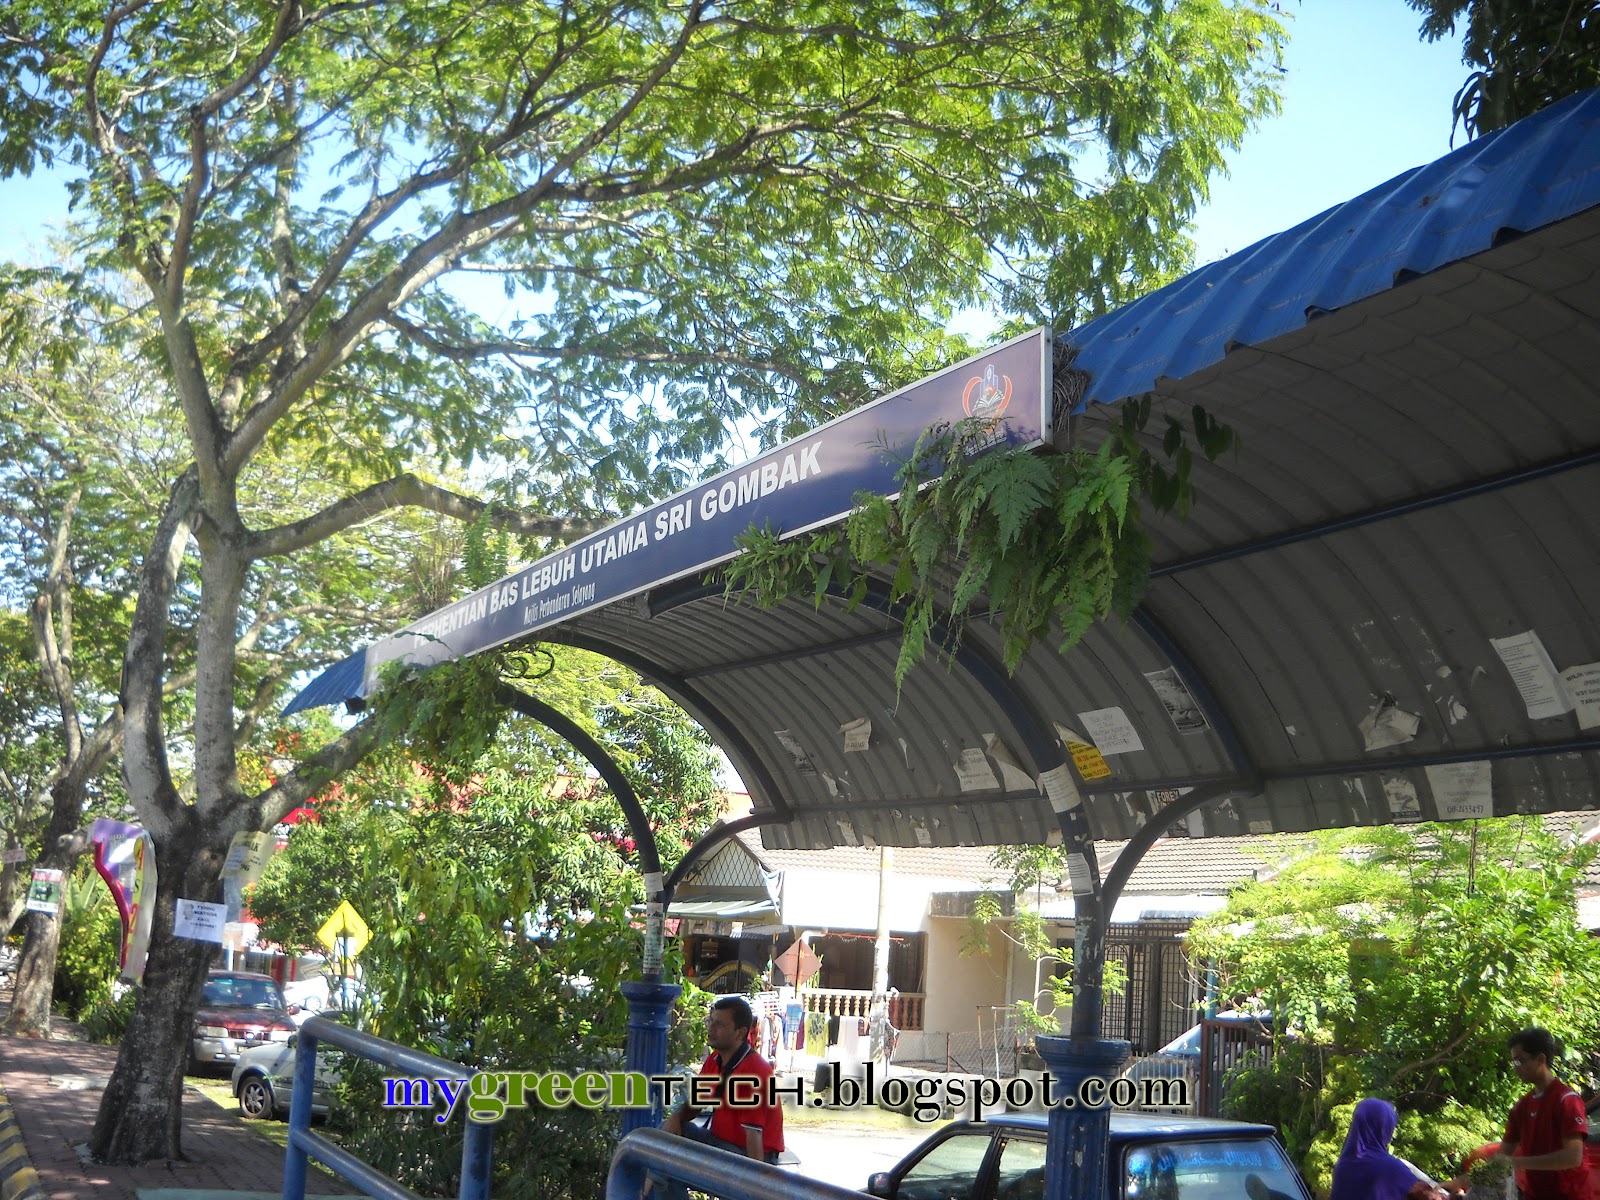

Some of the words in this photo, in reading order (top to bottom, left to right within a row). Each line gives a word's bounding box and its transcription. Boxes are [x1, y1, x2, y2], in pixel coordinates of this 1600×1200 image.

[489, 581, 519, 615] BAS
[522, 557, 576, 600] LEBUH
[580, 520, 649, 573] UTAMA
[654, 499, 692, 541] SRI
[700, 440, 822, 521] GOMBAK
[571, 581, 596, 607] Selayang
